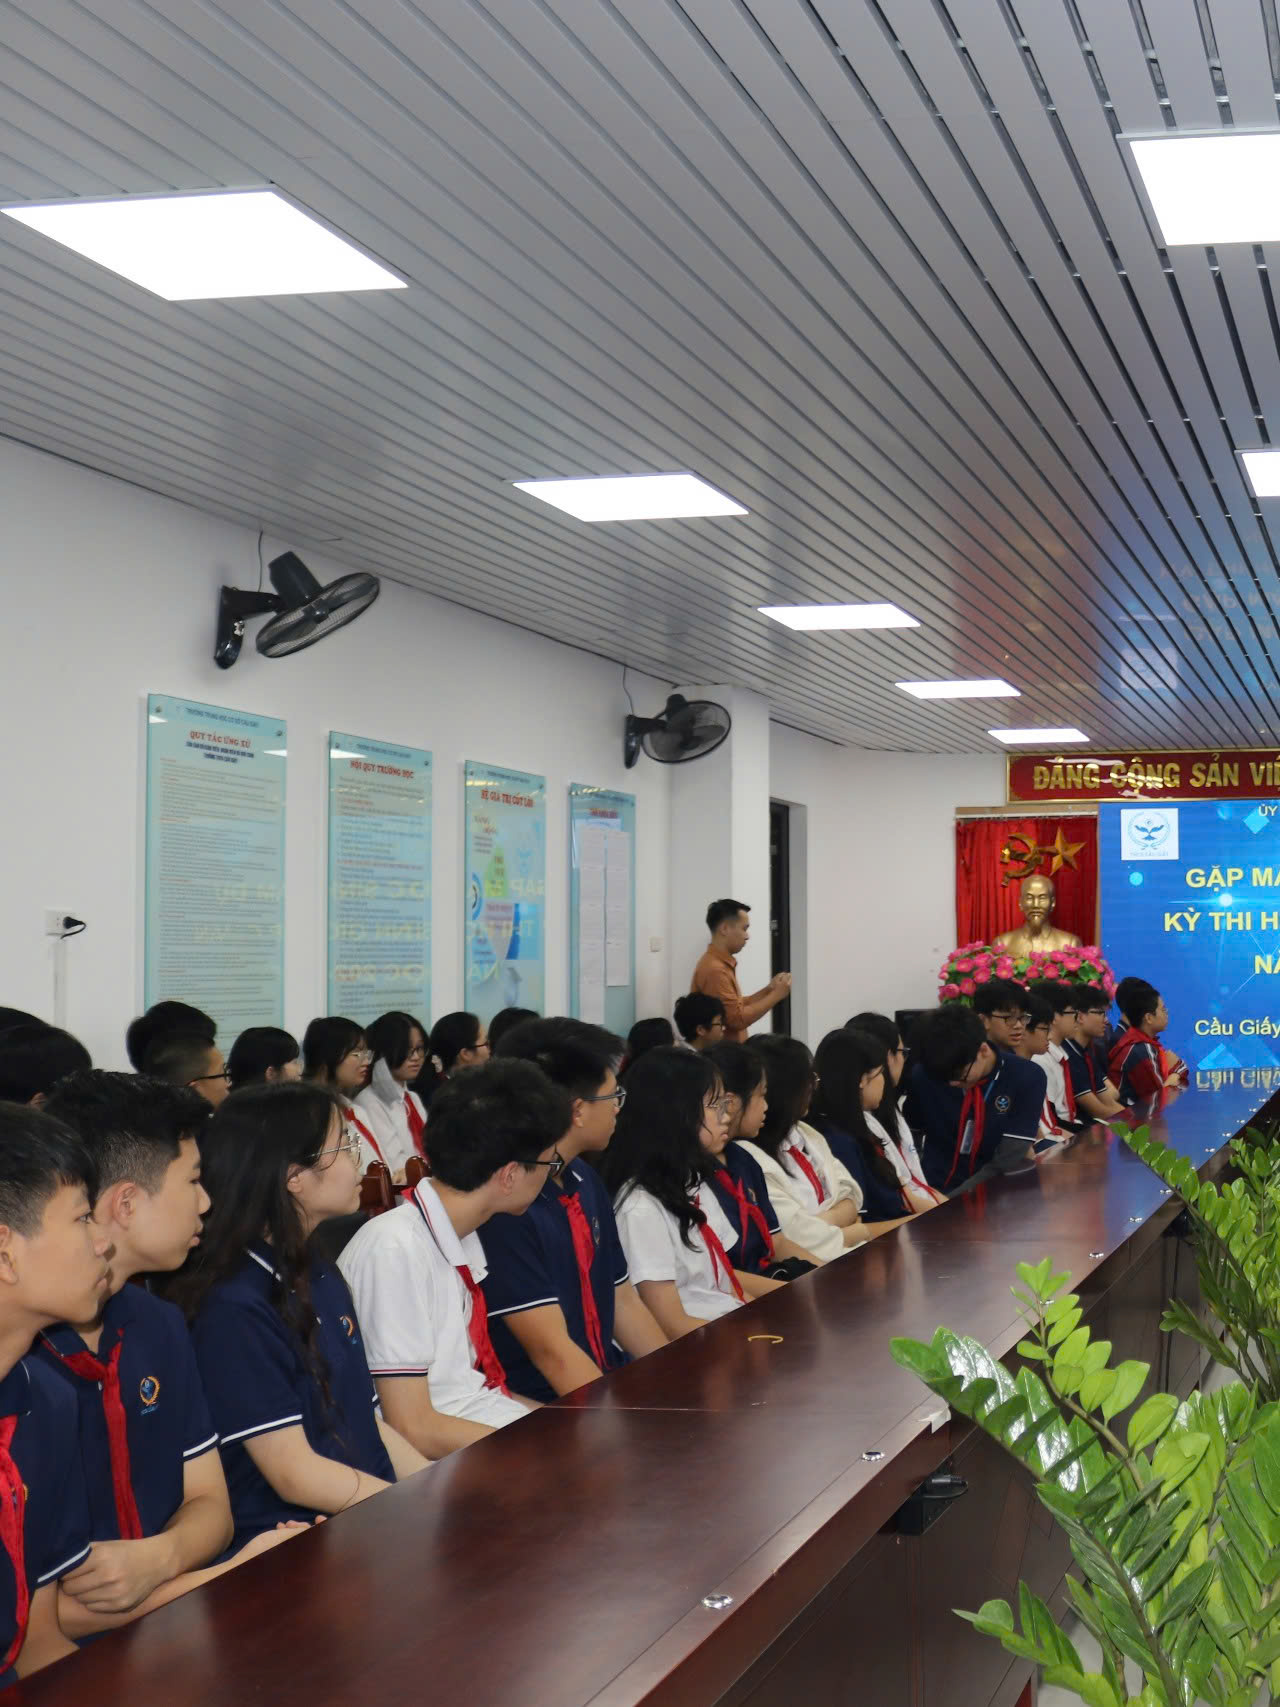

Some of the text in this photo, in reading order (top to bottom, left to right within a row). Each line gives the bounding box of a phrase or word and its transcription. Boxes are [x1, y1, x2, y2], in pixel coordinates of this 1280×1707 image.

[1033, 755, 1100, 789] ĐẢNG
[1110, 756, 1181, 793] CỘNG
[1189, 752, 1239, 787] SẢN
[1258, 803, 1278, 817] ỦY
[1185, 864, 1244, 892] GẶP
[1164, 907, 1201, 932] KỲ
[1208, 911, 1252, 931] THI
[1194, 1016, 1233, 1036] Cầu
